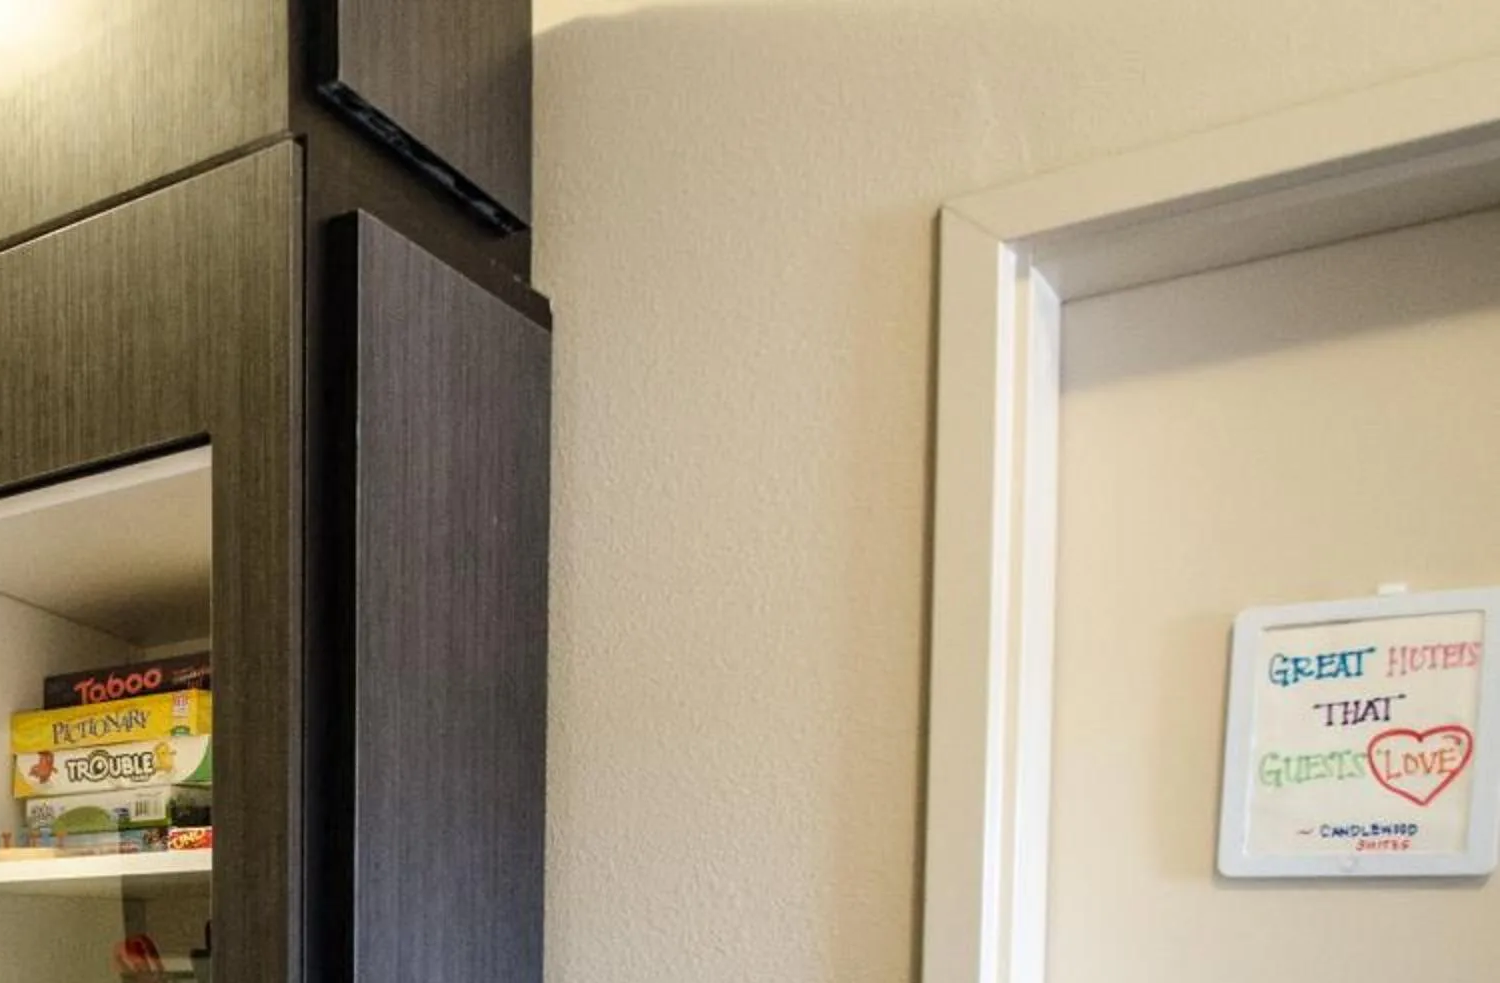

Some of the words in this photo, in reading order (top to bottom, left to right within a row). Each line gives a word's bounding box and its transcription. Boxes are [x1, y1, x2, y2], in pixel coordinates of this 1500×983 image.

[1269, 646, 1376, 687] GREAT
[1312, 694, 1407, 727] THAT
[64, 751, 157, 783] TROUBLE
[1257, 750, 1370, 788] GUESTS
[1380, 745, 1460, 781] LOVE
[1319, 823, 1419, 838] CANDLEWOOD
